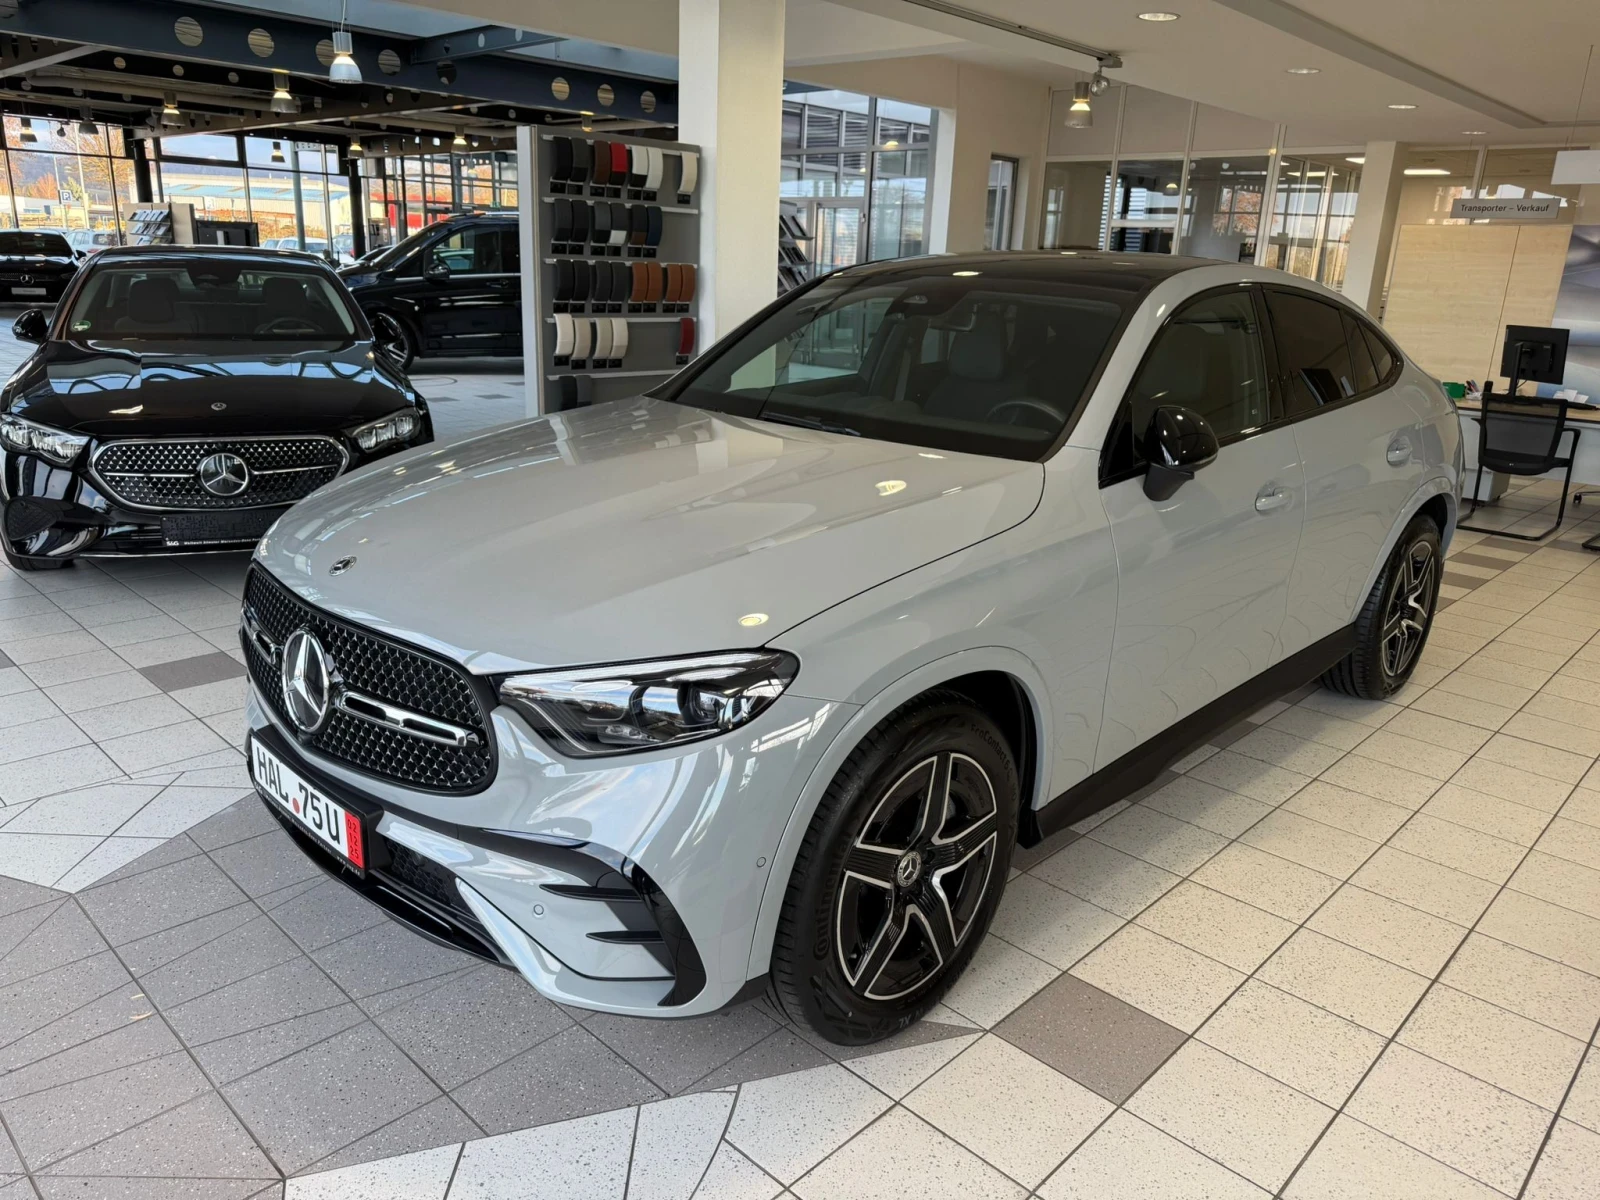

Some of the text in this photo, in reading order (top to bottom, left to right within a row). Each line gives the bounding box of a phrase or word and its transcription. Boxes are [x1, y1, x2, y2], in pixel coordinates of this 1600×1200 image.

[1461, 205, 1507, 213] Transporter
[1517, 204, 1549, 212] Verkauf
[257, 746, 341, 845] HAL 75U
[347, 819, 357, 832] 02
[349, 832, 358, 846] 12
[349, 845, 359, 859] 25
